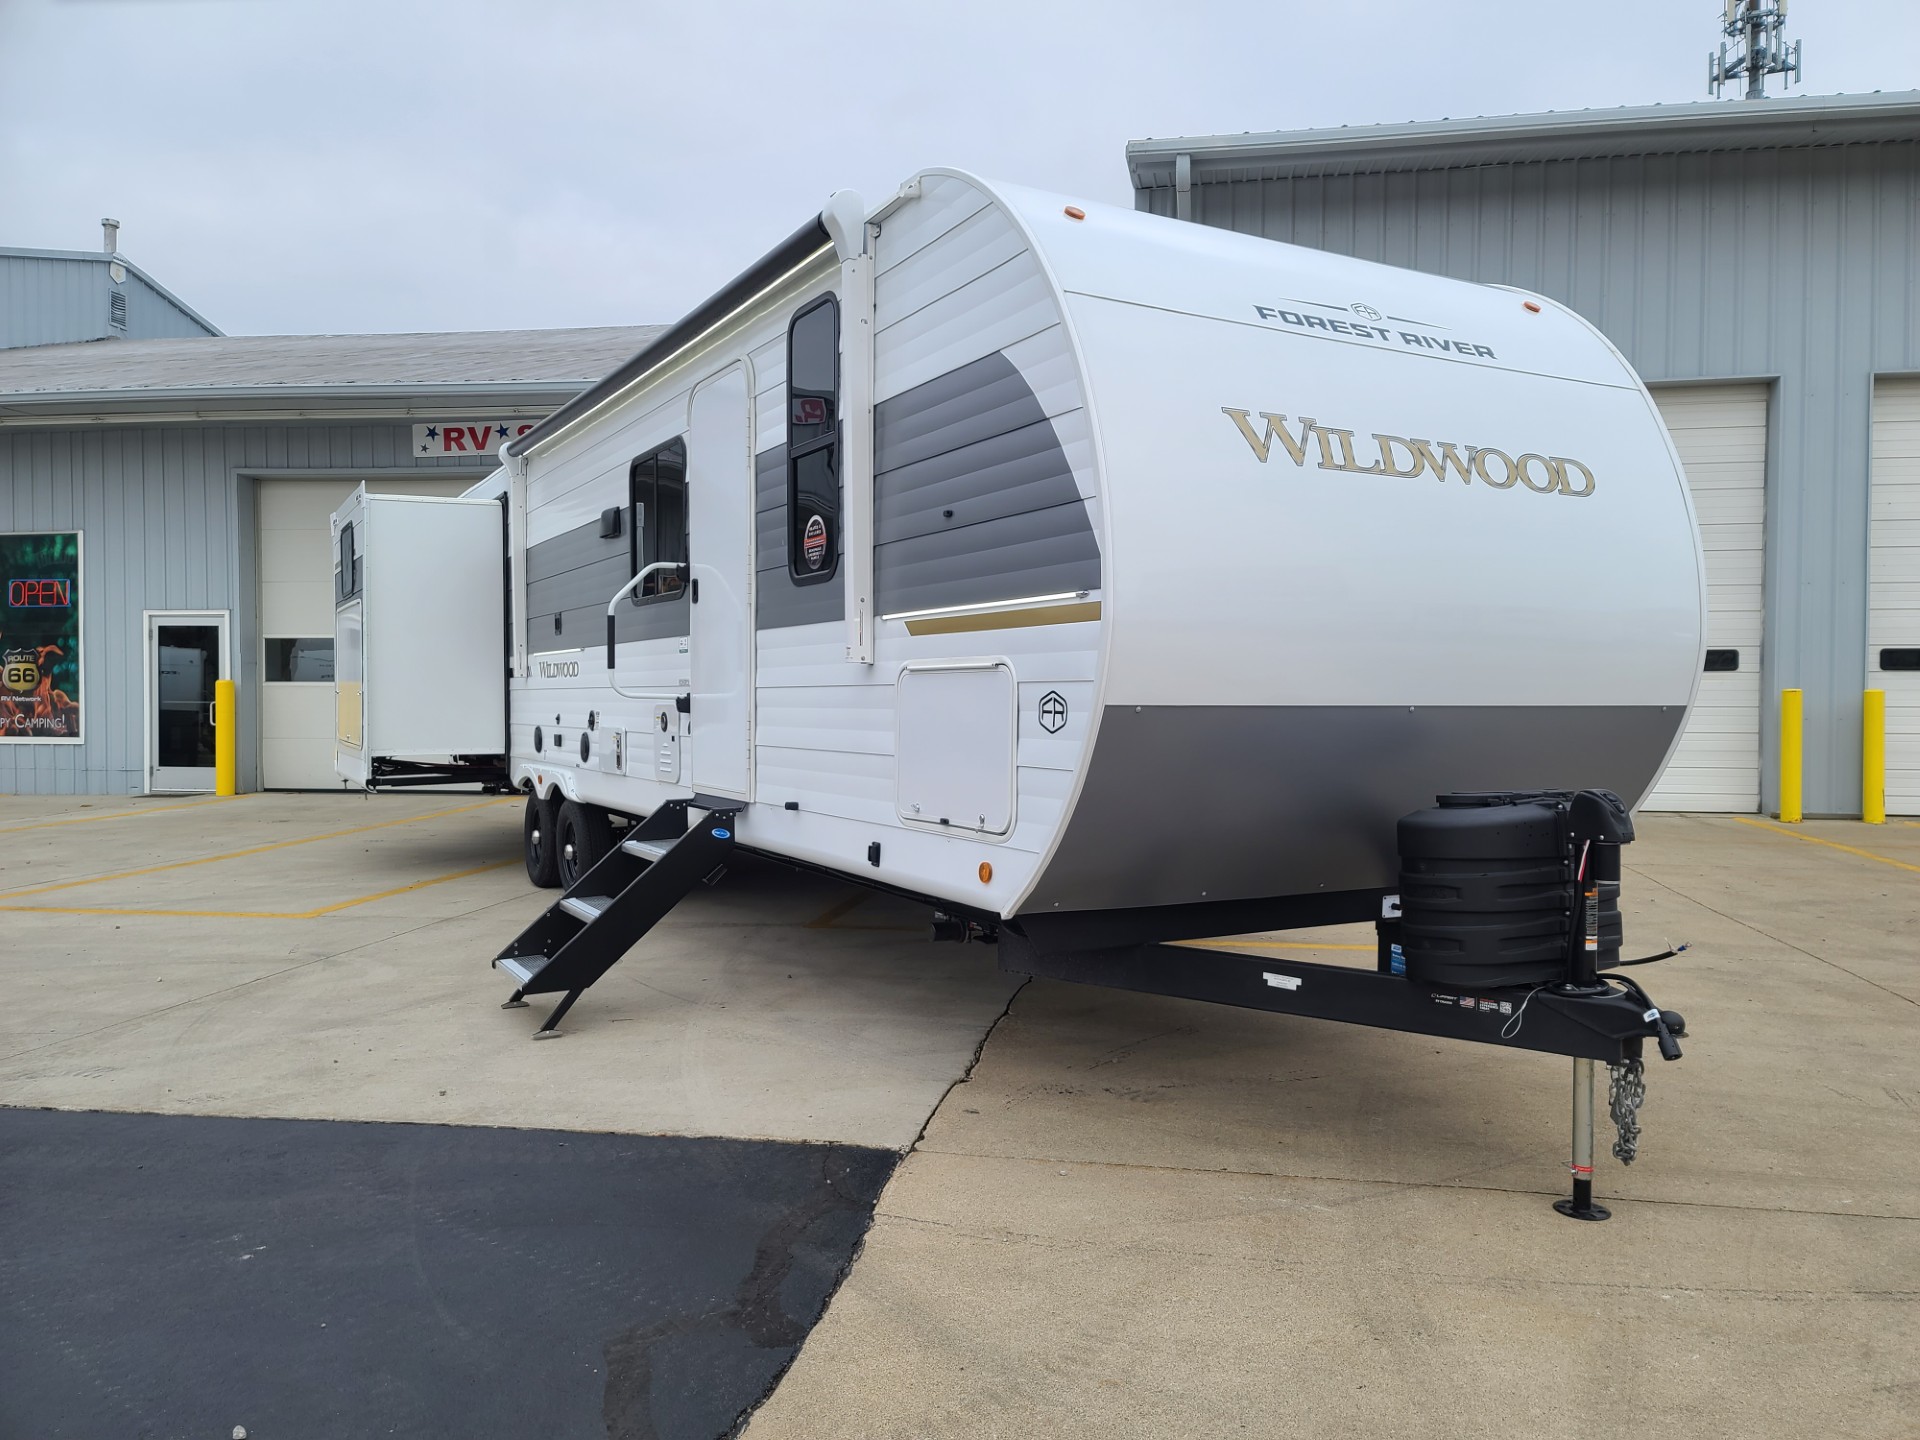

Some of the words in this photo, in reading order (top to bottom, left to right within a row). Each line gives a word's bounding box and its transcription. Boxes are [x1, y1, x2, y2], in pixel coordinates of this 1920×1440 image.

[1252, 304, 1391, 342] FOREST
[1397, 330, 1498, 361] RIVER
[442, 425, 493, 452] RV
[1221, 406, 1596, 498] WILDWOOD
[10, 581, 69, 606] OPEN
[8, 654, 35, 662] ROUTE
[8, 667, 35, 683] 66
[538, 660, 580, 679] WILDWOOD
[0, 717, 11, 728] PY
